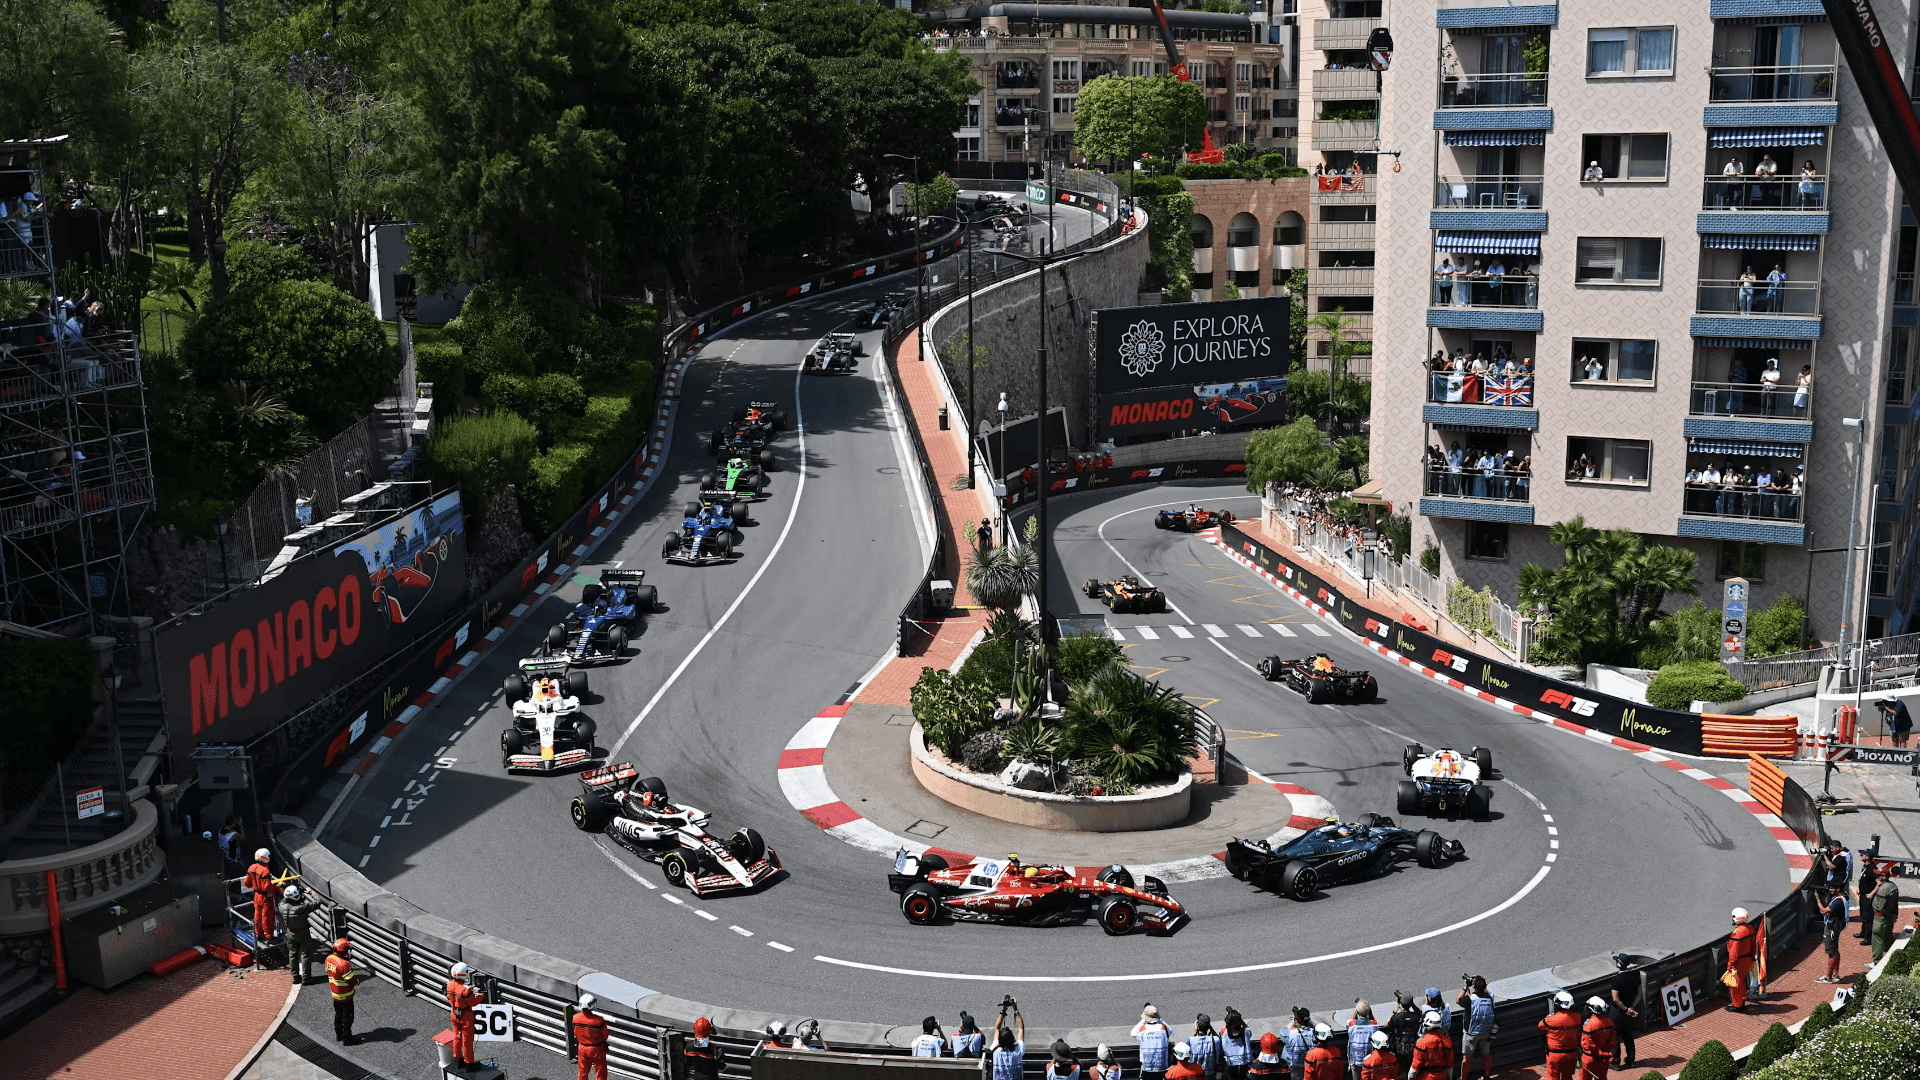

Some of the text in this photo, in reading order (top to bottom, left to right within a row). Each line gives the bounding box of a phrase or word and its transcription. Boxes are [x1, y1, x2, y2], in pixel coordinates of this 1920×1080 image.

[1173, 314, 1264, 340] EXPLORA
[1170, 337, 1271, 371] JOURNEYS
[1110, 398, 1194, 426] MONACO
[189, 575, 361, 735] MONACO
[1620, 708, 1672, 738] Monaco
[1854, 749, 1913, 763] PIOVANO
[1338, 850, 1367, 866] aramco
[1666, 985, 1691, 1017] SC
[473, 1010, 507, 1036] SC
